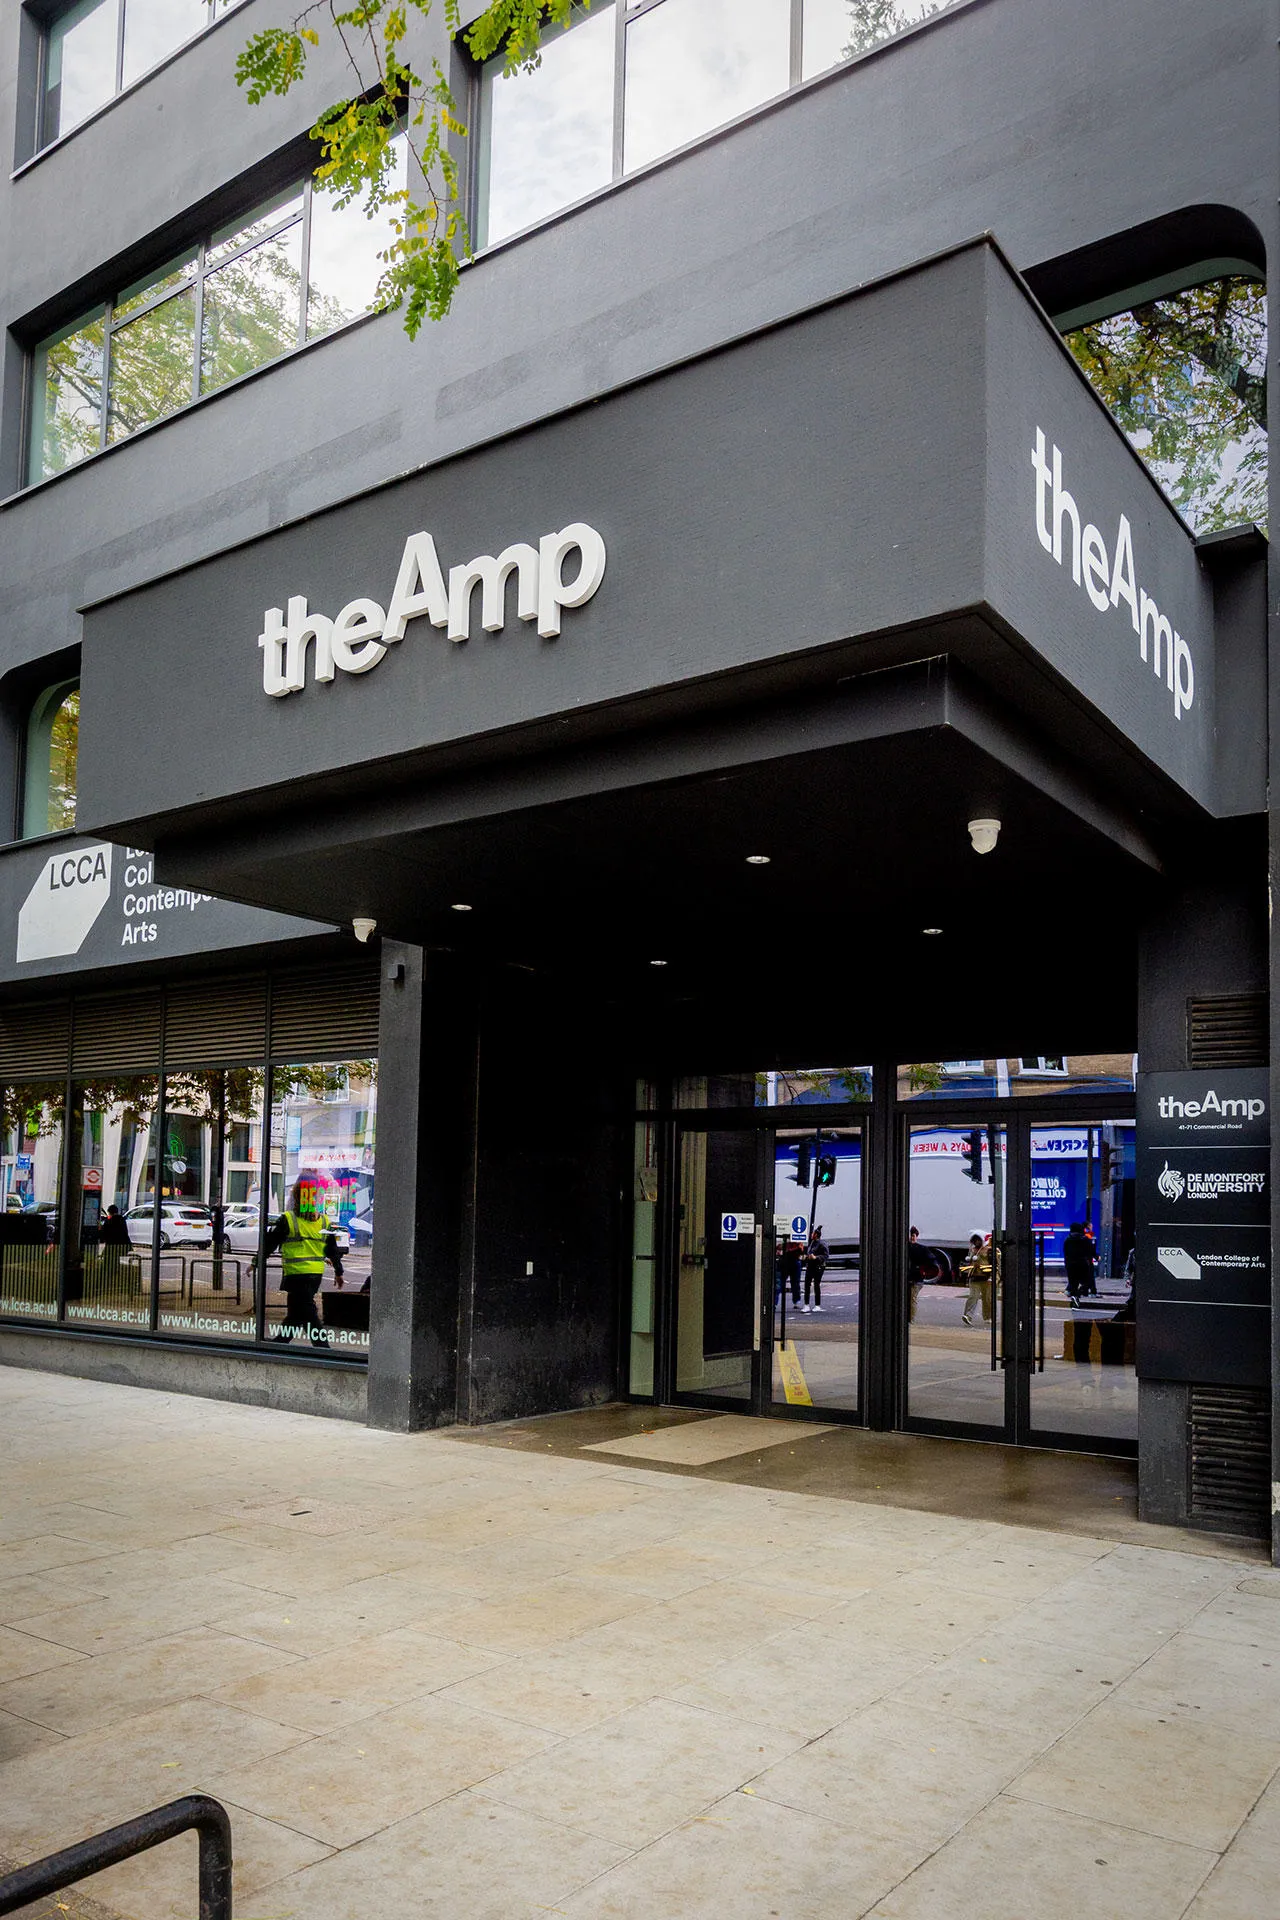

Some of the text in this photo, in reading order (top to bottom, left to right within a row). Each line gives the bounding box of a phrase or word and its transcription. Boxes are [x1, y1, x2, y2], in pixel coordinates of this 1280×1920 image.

[1031, 425, 1194, 721] theAmp
[258, 522, 606, 698] theAmp
[50, 851, 107, 890] LCCA
[121, 921, 158, 946] Arts
[1158, 1090, 1266, 1121] theAmp
[1187, 1173, 1266, 1182] DE MONTFORT
[1187, 1182, 1265, 1193] UNIVERSITY
[1201, 1260, 1250, 1269] Contemporary
[1223, 1254, 1250, 1262] College
